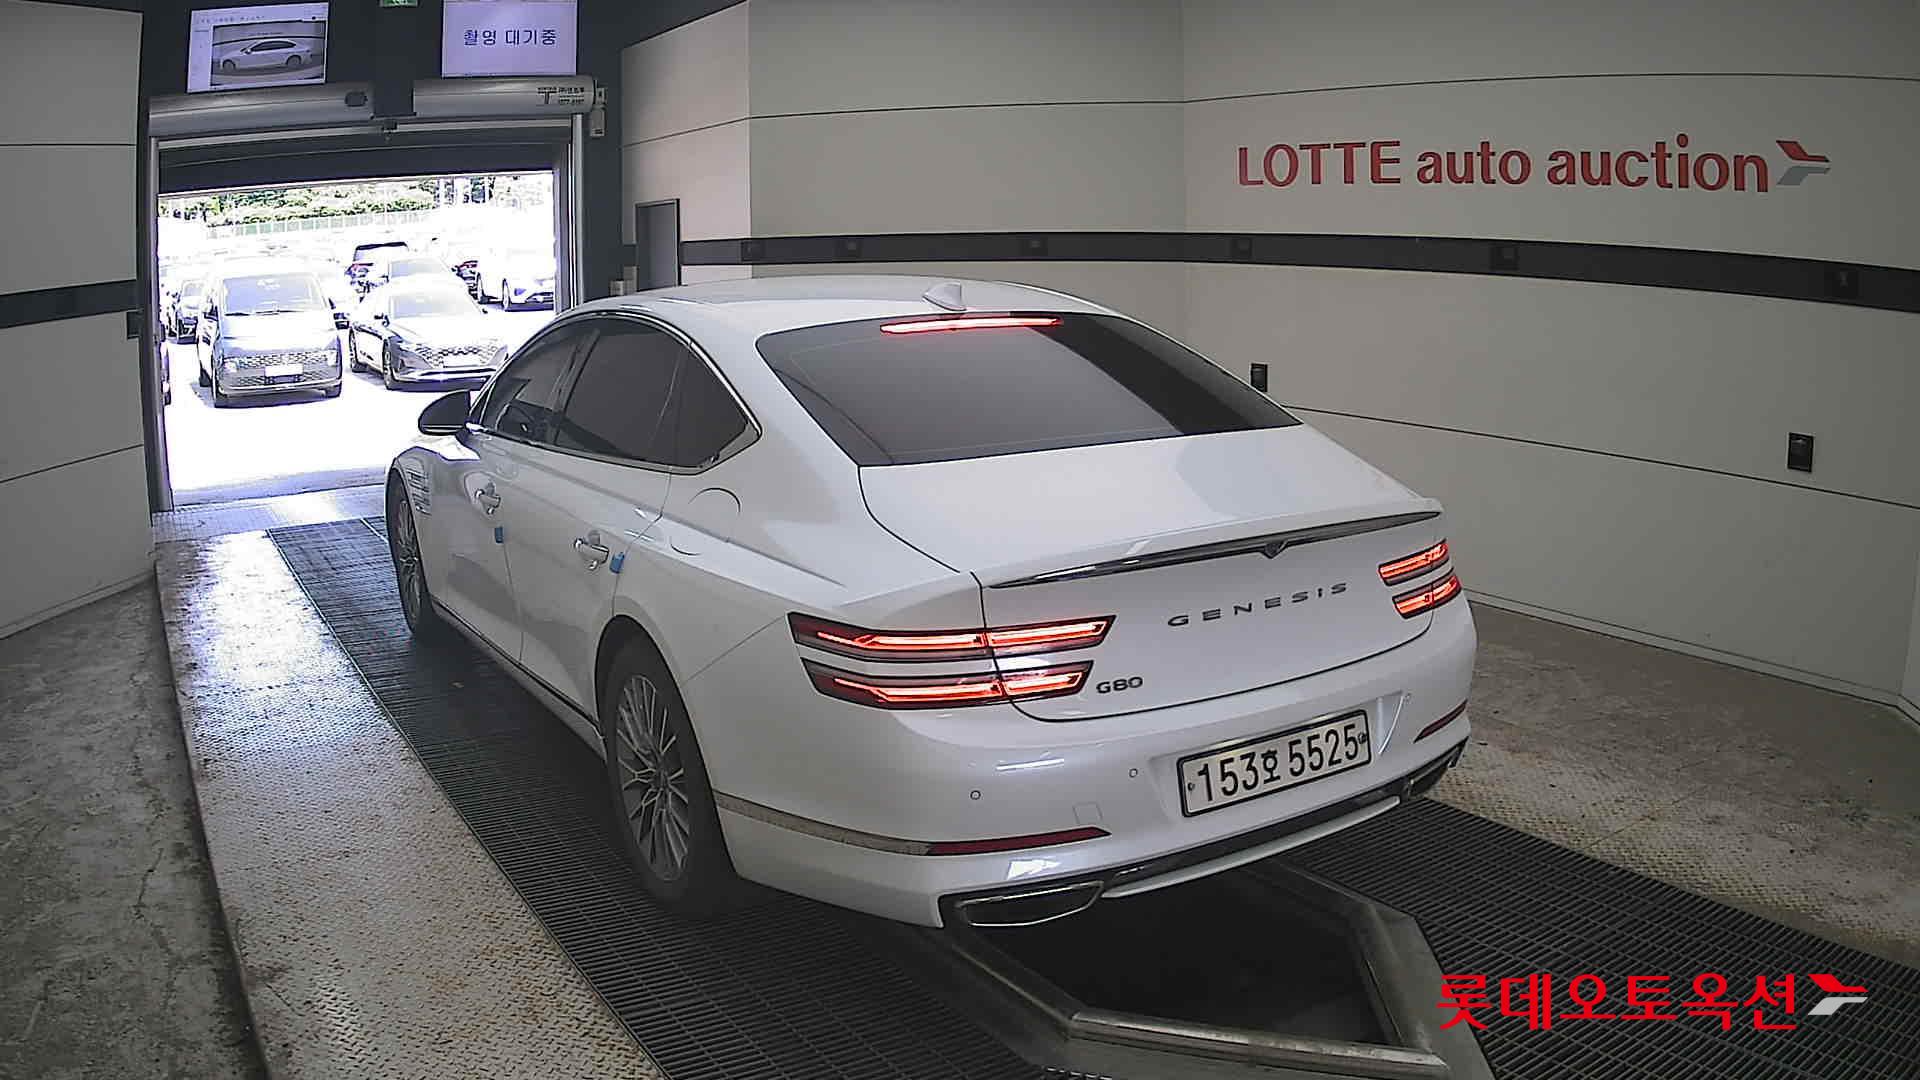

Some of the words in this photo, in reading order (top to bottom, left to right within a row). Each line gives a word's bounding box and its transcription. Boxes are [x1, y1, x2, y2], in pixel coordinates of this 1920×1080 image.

[505, 29, 557, 46] 대기중
[1238, 140, 1400, 186] LOTTE
[1417, 141, 1532, 185] auto
[1547, 134, 1769, 192] auction
[1168, 583, 1347, 627] GENESIS
[1096, 677, 1144, 694] G80
[1197, 749, 1281, 802] 153호
[1288, 723, 1359, 777] 5525
